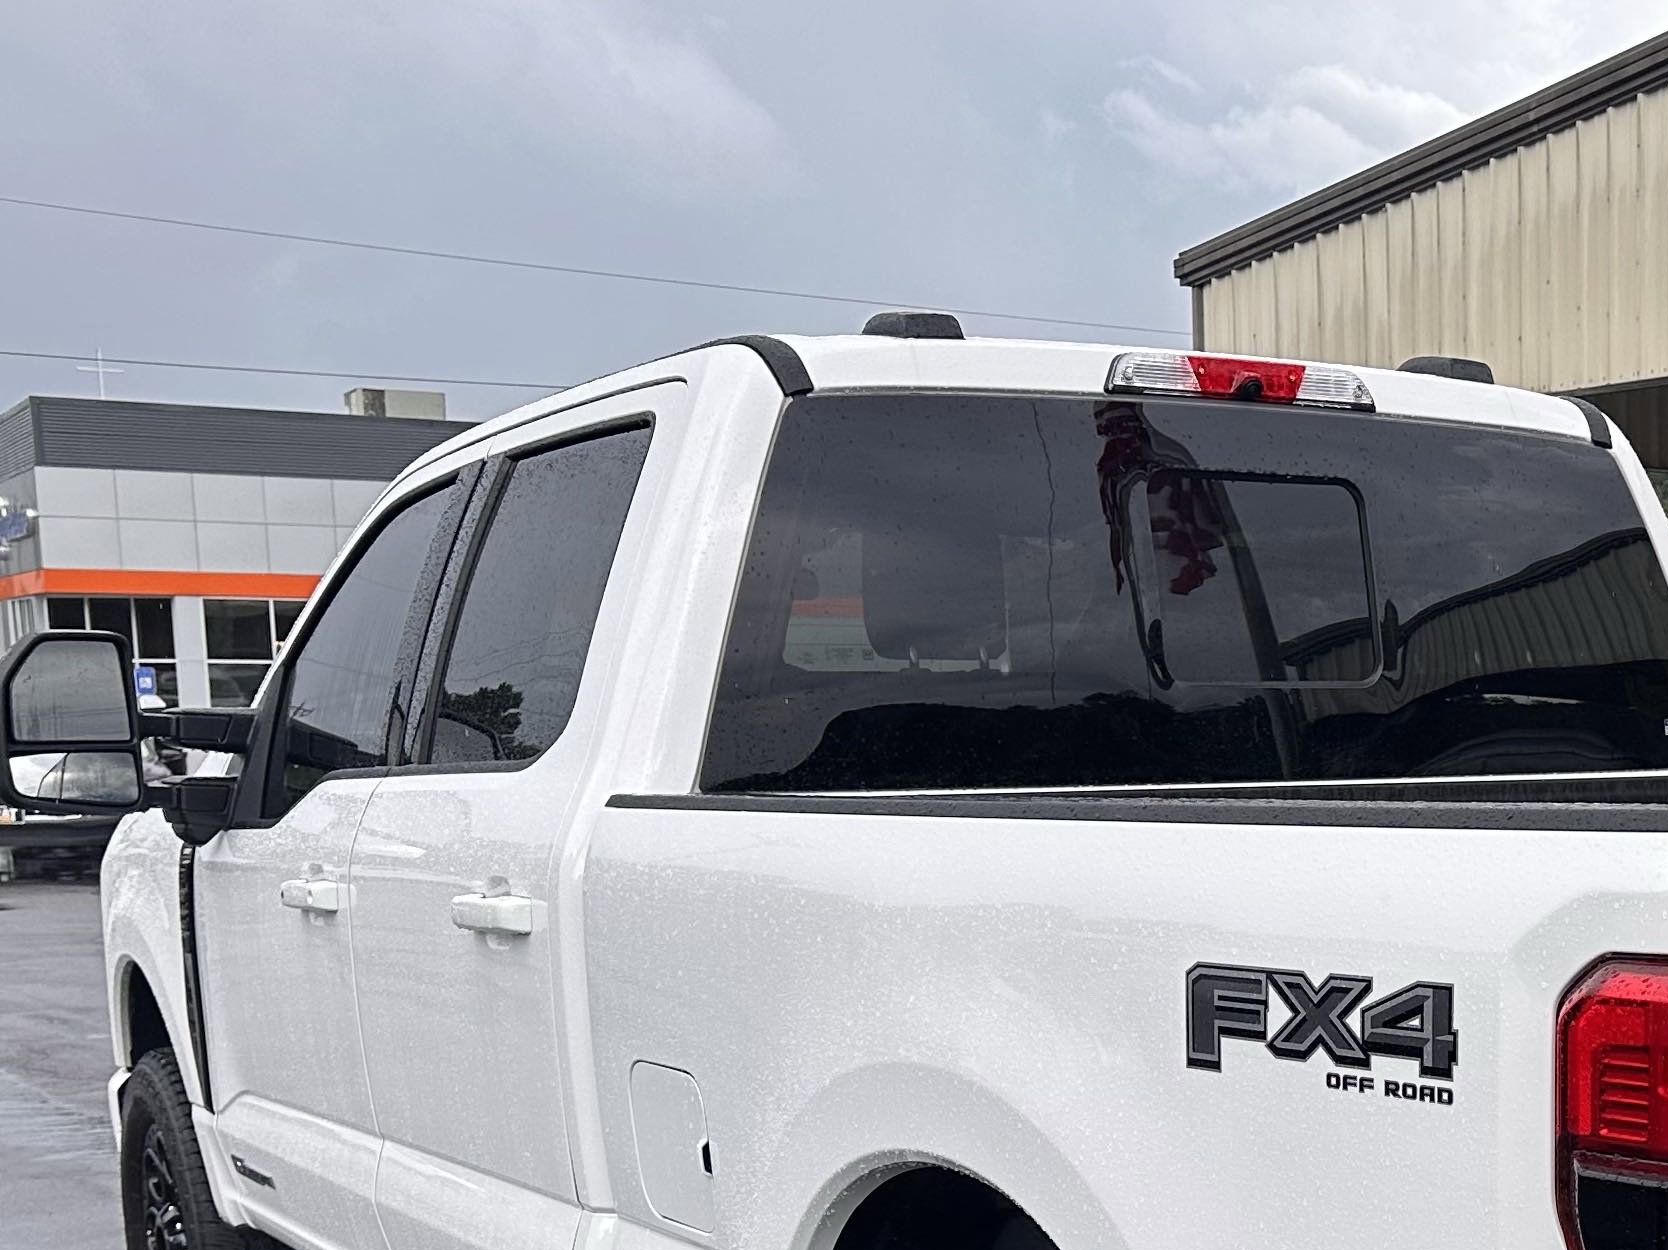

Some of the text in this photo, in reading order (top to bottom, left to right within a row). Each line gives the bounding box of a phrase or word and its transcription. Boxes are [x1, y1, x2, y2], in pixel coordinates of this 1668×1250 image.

[1186, 961, 1458, 1082] FX4
[1326, 1072, 1454, 1106] OFF ROAD
